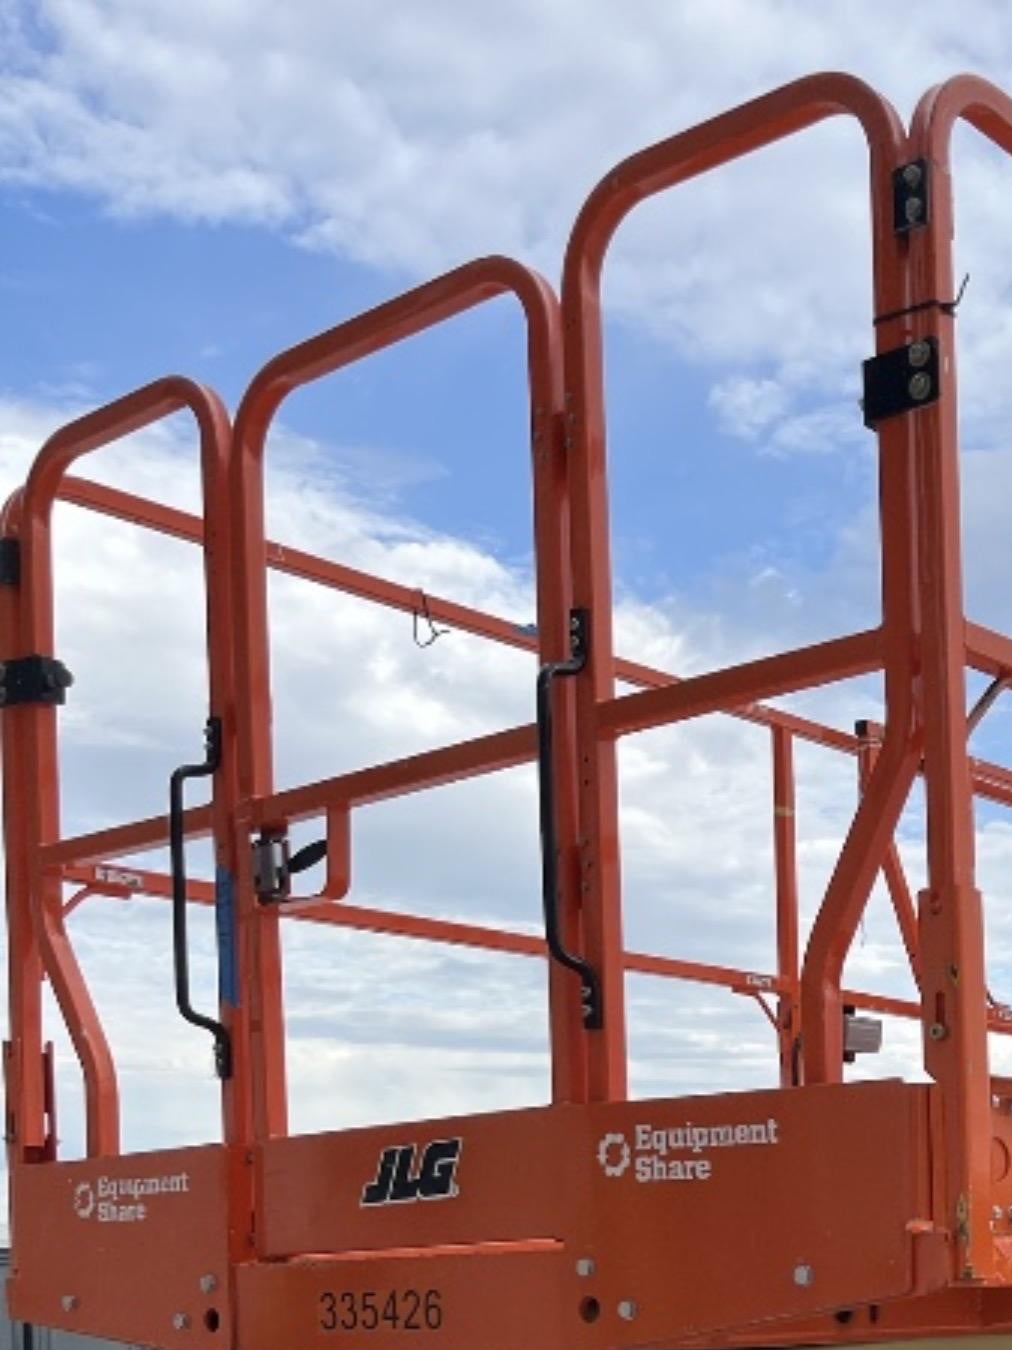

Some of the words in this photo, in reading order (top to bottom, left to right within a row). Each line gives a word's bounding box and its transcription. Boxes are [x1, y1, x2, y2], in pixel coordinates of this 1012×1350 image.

[635, 1119, 778, 1155] Equipment
[360, 1137, 463, 1208] JLG
[635, 1156, 712, 1183] Share
[97, 1173, 189, 1200] Equipment
[97, 1202, 146, 1222] Share
[320, 1289, 443, 1331] 335426
